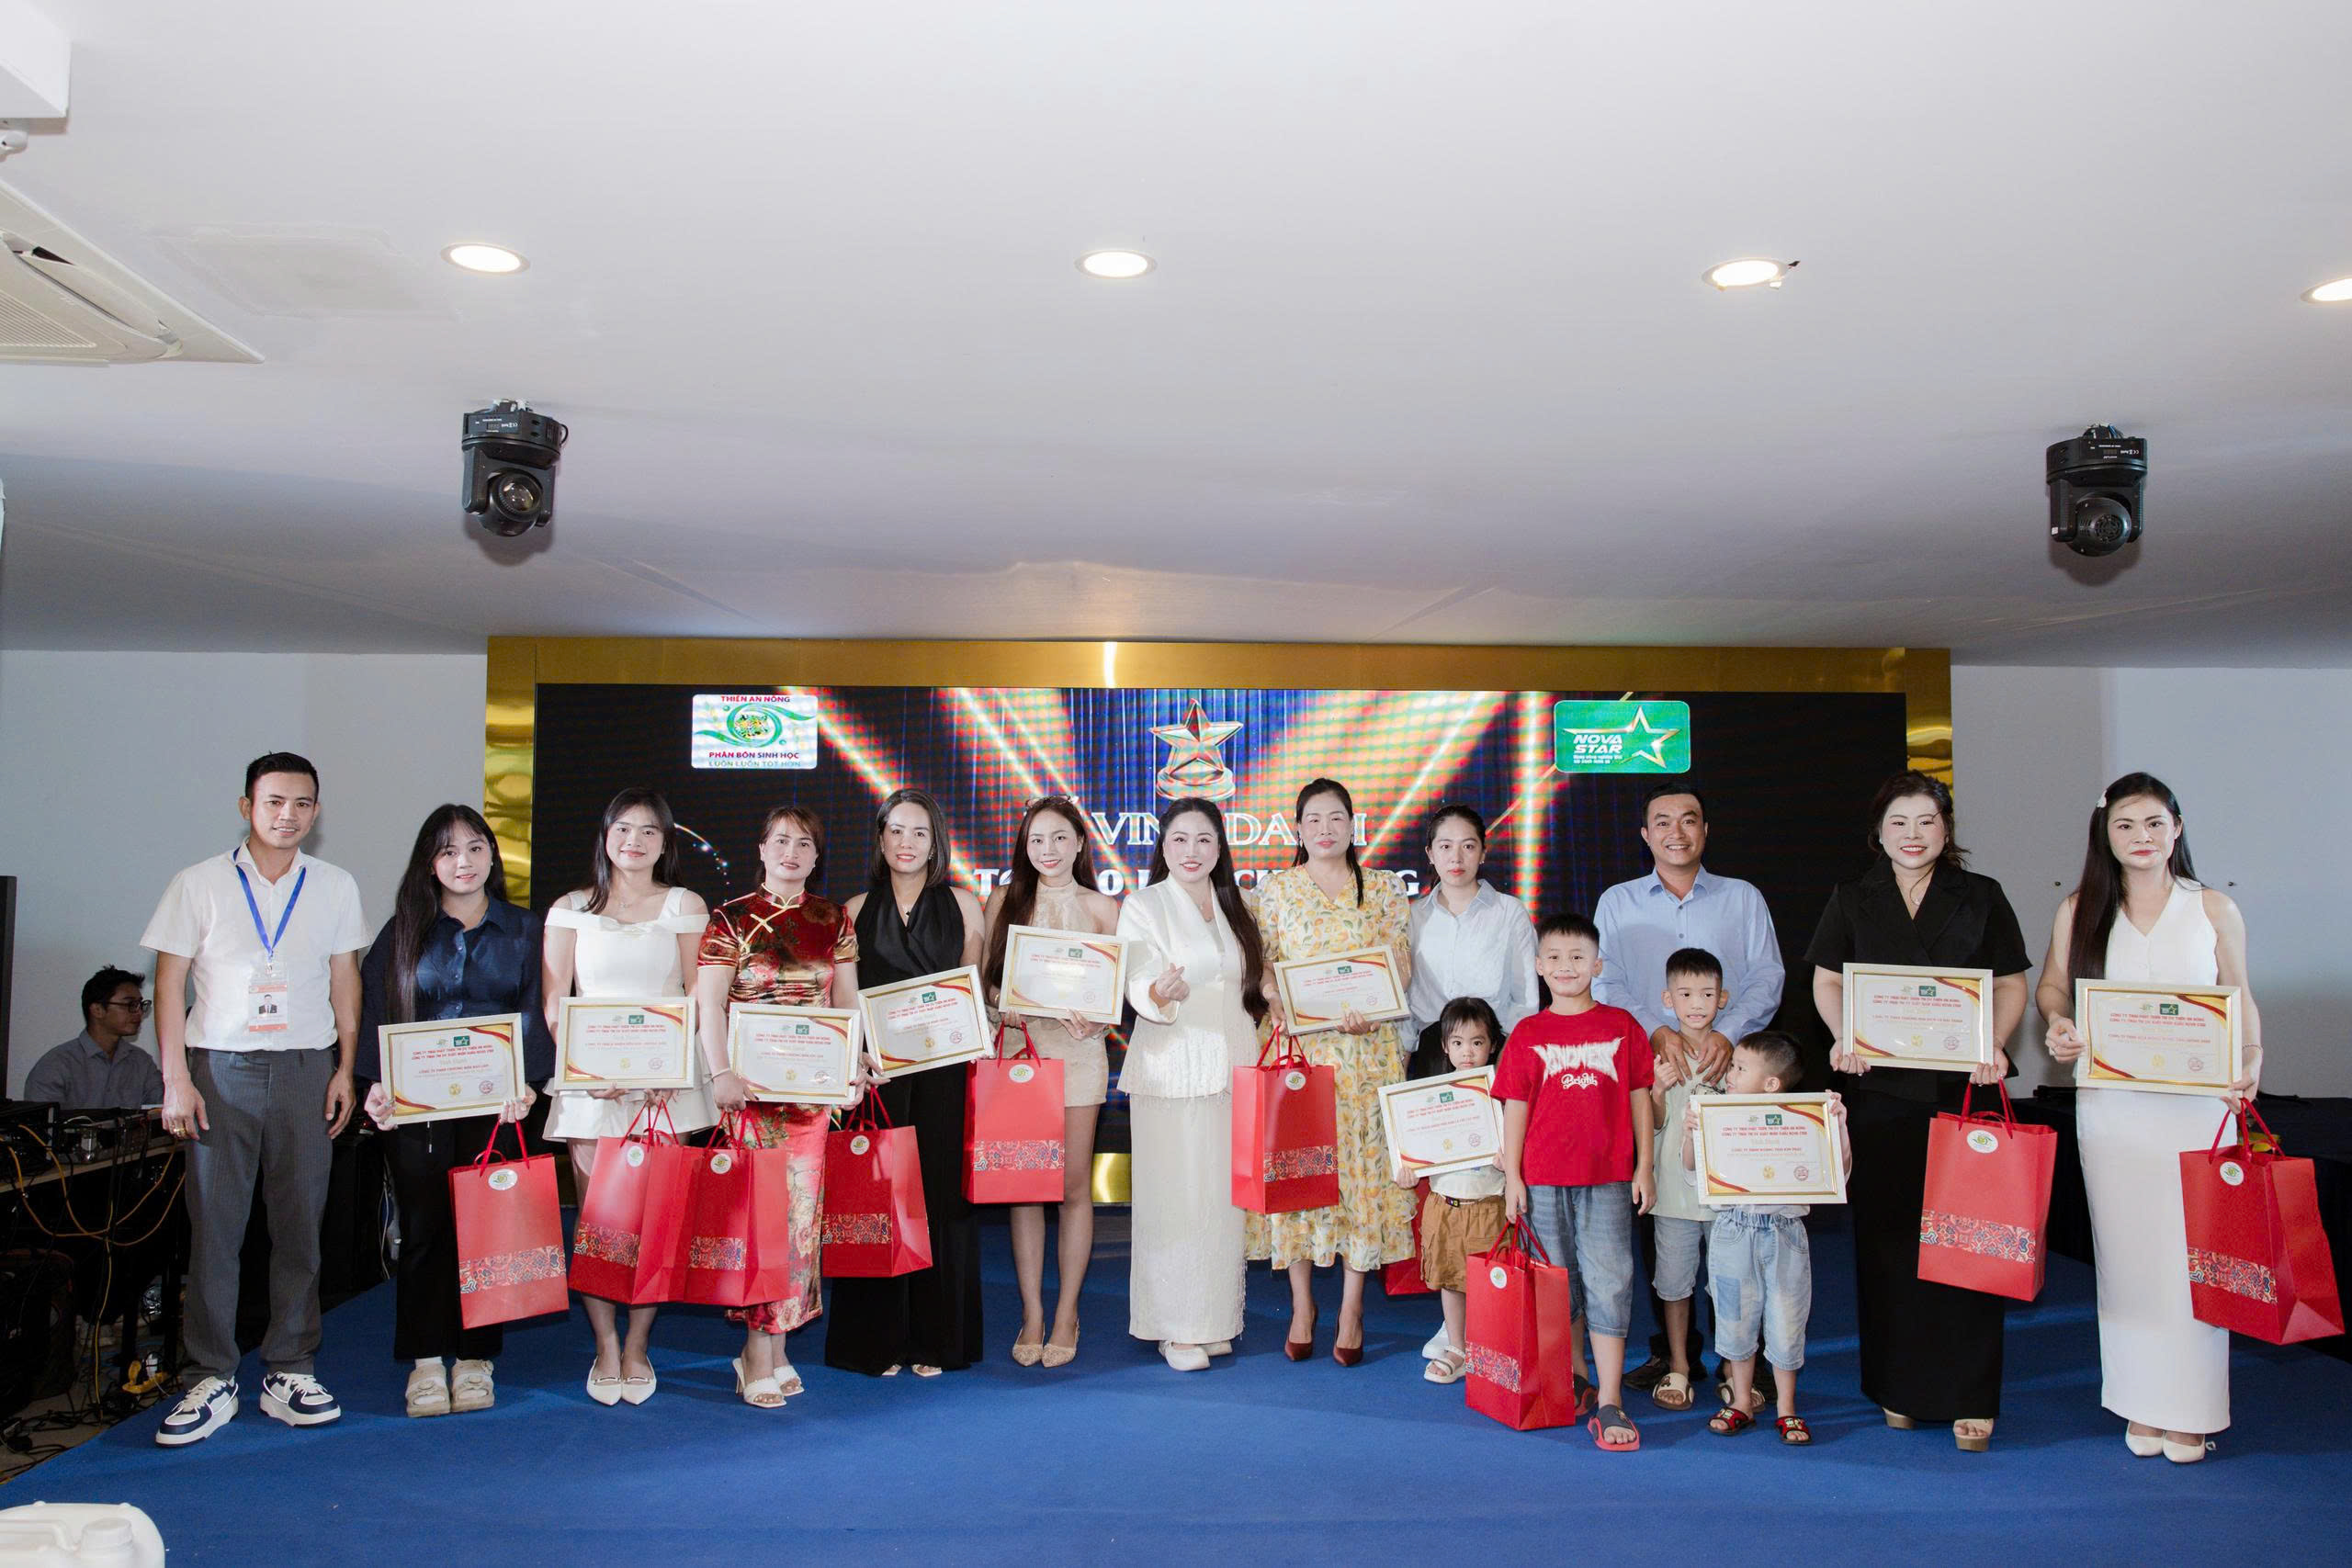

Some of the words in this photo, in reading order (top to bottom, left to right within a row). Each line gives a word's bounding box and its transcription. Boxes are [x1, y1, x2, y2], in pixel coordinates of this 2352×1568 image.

[1573, 735, 1623, 744] NOVA
[1573, 744, 1623, 753] STAR
[780, 751, 799, 760] HỌC
[1562, 1072, 1598, 1089] Bright
